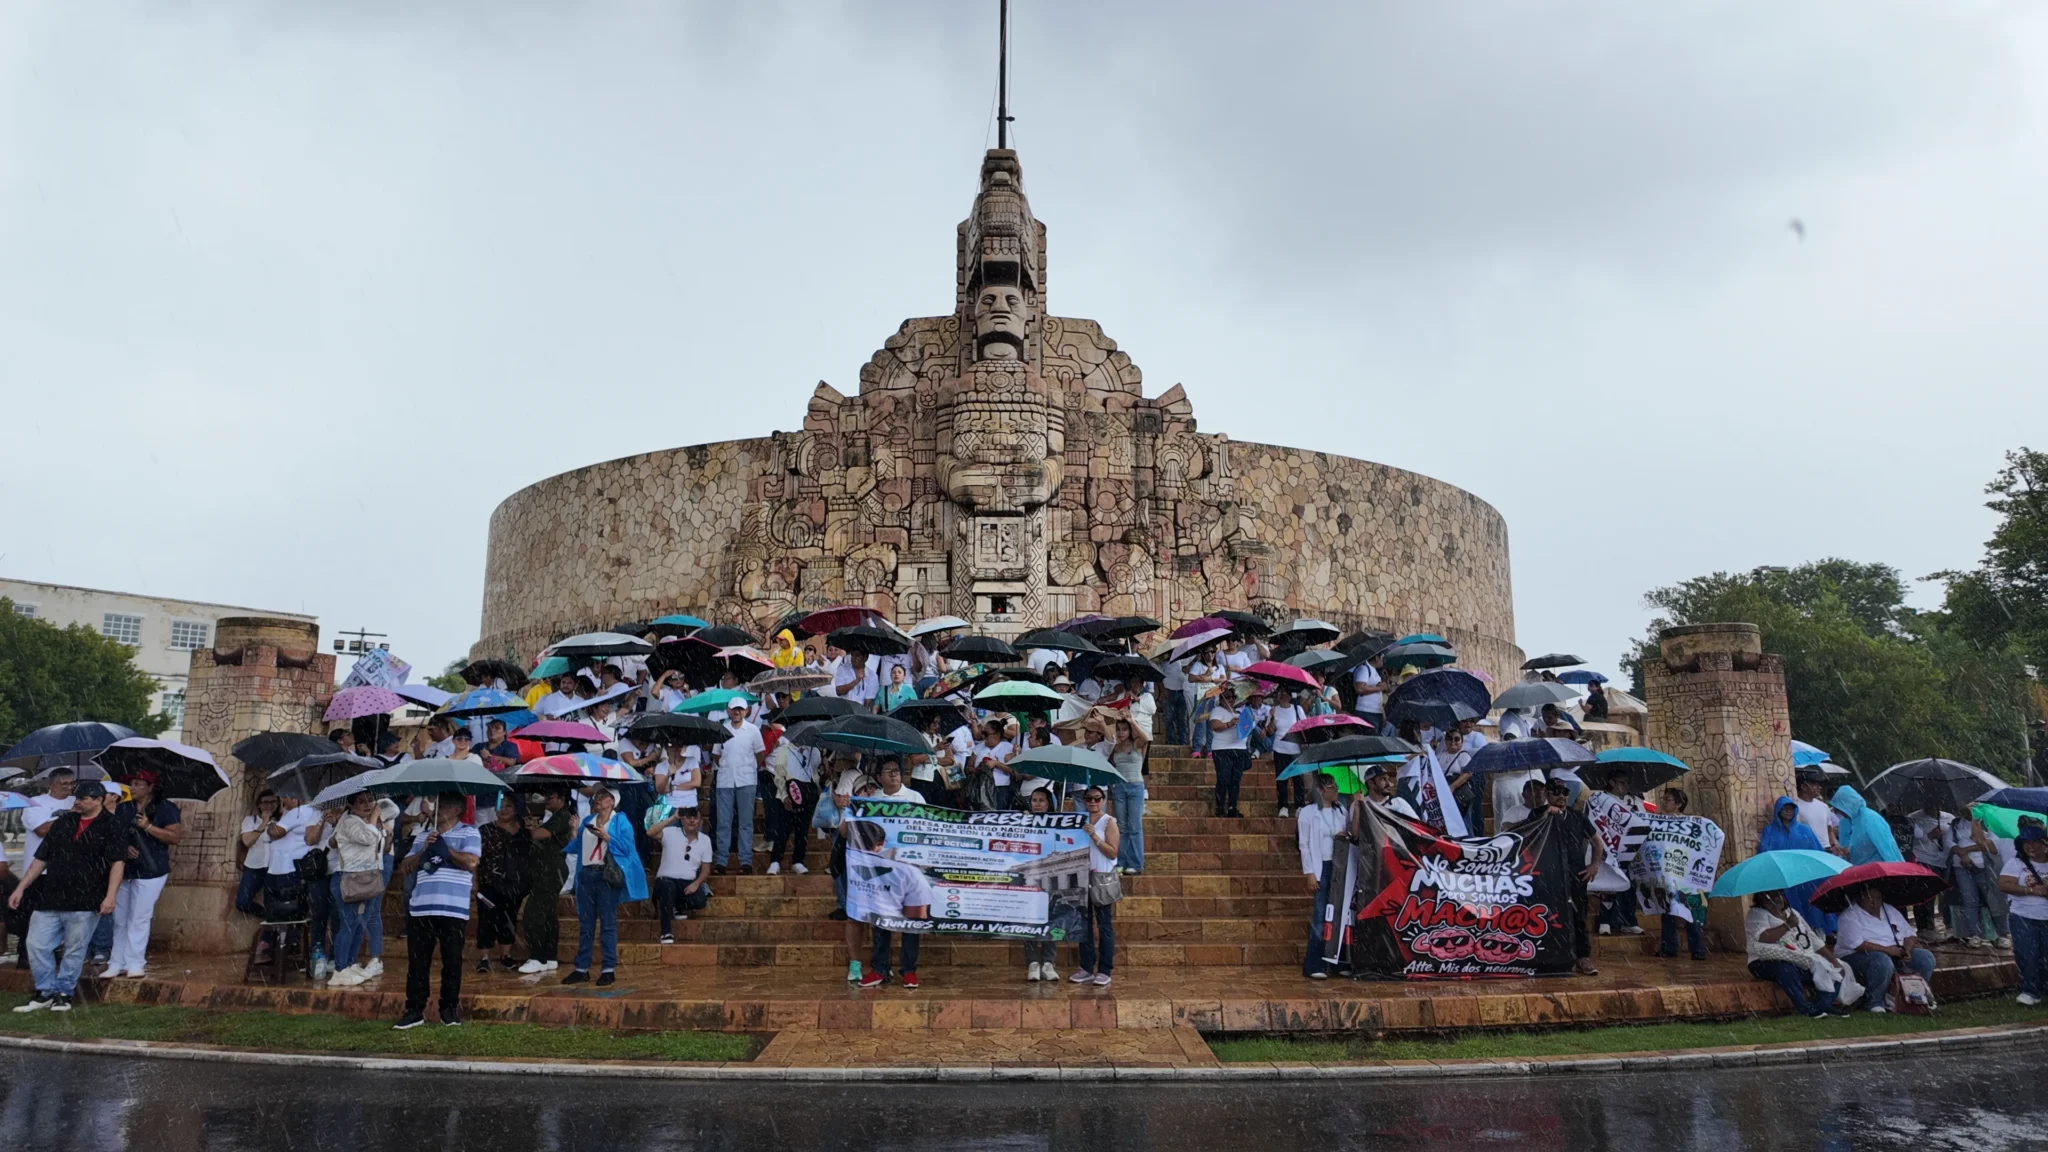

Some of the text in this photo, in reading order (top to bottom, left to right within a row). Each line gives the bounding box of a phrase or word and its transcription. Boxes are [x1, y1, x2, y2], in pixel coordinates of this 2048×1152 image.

[916, 820, 939, 828] MESA
[1000, 826, 1048, 835] NACIONAL
[968, 812, 1083, 828] PRESENTE!
[927, 826, 957, 834] SNTSS
[1649, 820, 1694, 836] MSS
[944, 840, 980, 849] OCTUBRE
[1421, 854, 1449, 872] No
[1409, 868, 1534, 897] MUCHAS
[1437, 889, 1519, 904] pero somos
[1396, 895, 1548, 937] MACH@S
[937, 922, 969, 931] HASTA
[970, 923, 985, 931] LA
[1438, 962, 1460, 974] Mis
[1461, 962, 1481, 973] dos
[1484, 964, 1537, 976] neuronas
